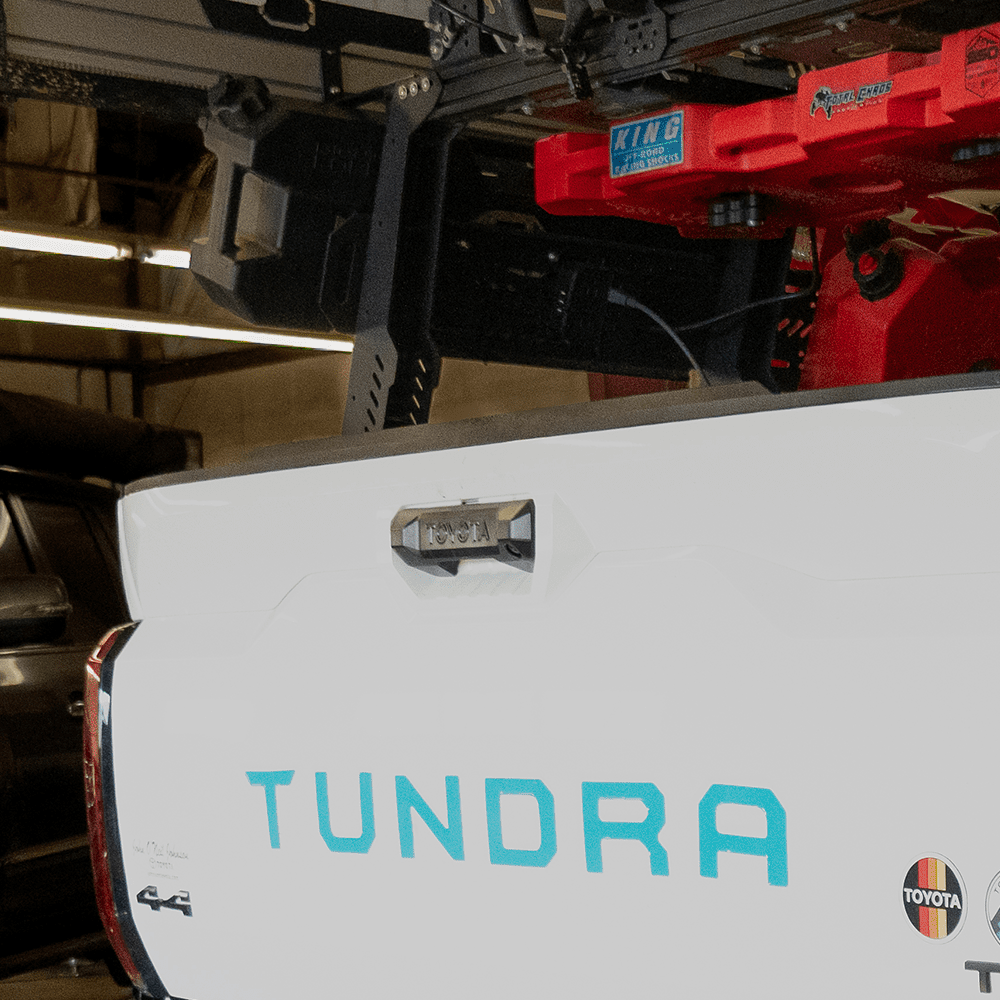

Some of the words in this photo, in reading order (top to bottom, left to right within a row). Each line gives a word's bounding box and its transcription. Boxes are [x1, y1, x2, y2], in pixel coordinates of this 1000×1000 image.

[614, 116, 681, 151] KING
[426, 521, 490, 545] TOYOTA
[246, 770, 788, 887] TUNDRA
[904, 888, 962, 909] TOYOTA
